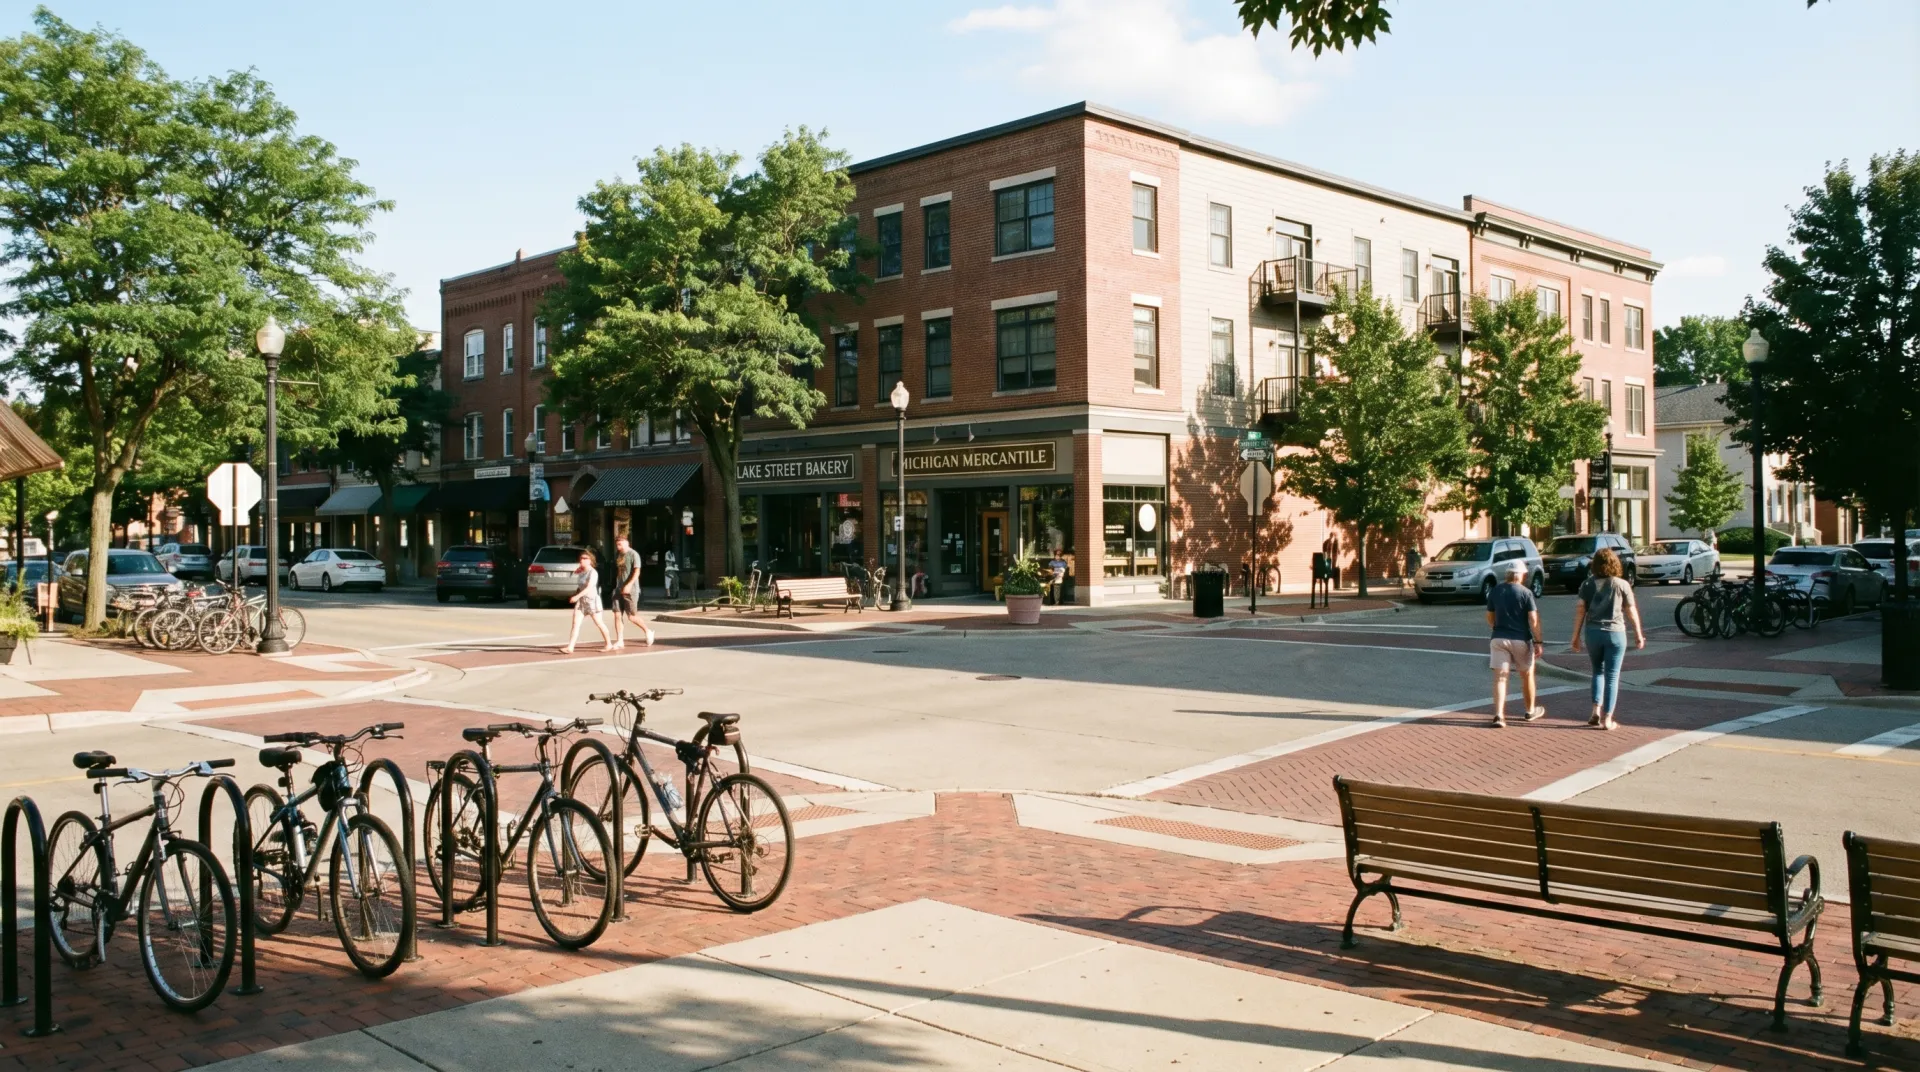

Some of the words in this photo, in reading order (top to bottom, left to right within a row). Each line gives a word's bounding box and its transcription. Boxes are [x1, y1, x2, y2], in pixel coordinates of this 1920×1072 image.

[963, 449, 1047, 468] MERCANTILE
[736, 464, 762, 479] LAKE
[764, 462, 802, 478] STREET
[805, 459, 849, 476] BAKERY
